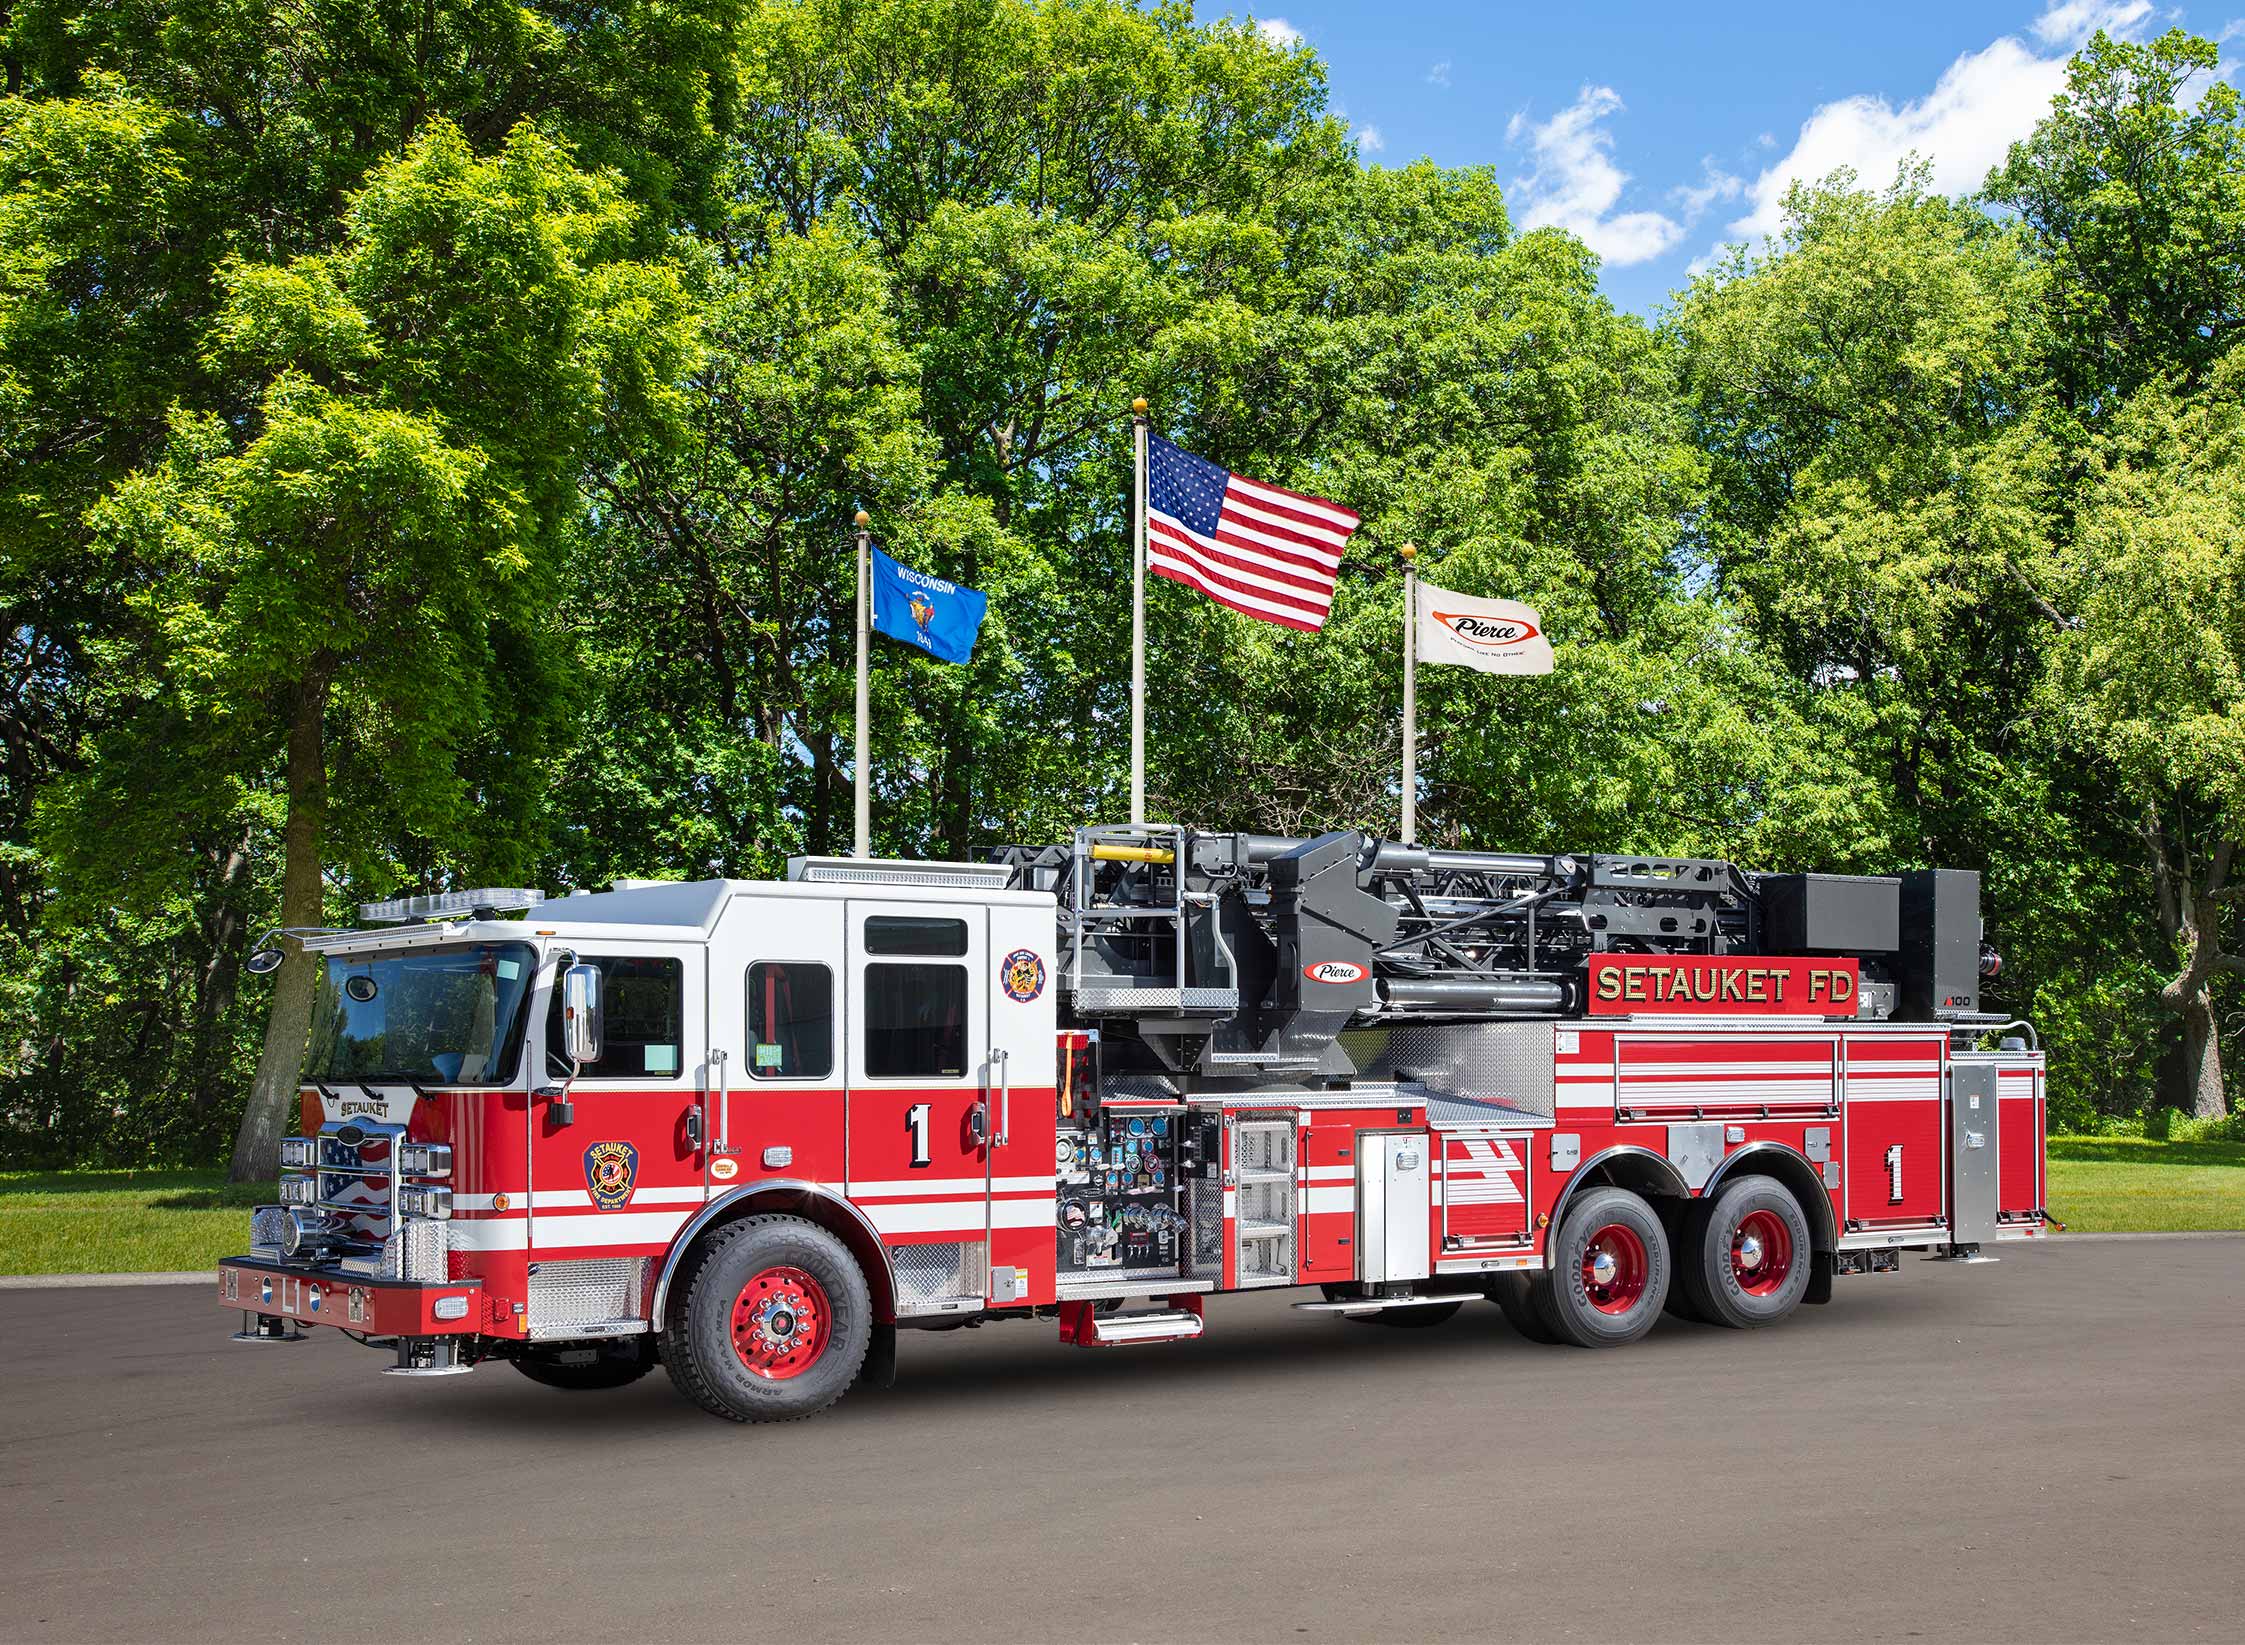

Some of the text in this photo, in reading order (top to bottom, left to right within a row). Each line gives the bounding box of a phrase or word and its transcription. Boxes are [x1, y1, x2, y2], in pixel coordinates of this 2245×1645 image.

[897, 566, 956, 595] WISCONSIN
[1455, 617, 1516, 639] Pierce
[1320, 964, 1355, 979] Pierce
[1597, 966, 1853, 1004] SETAUKET FD
[341, 1101, 389, 1118] SETAUKET
[905, 1103, 932, 1168] 1
[590, 1142, 633, 1159] SETAUKET
[1884, 1144, 1904, 1206] 1
[601, 1186, 632, 1204] DEPARTMENT
[717, 1338, 736, 1371] MAX
[735, 1373, 783, 1397] ARMOR
